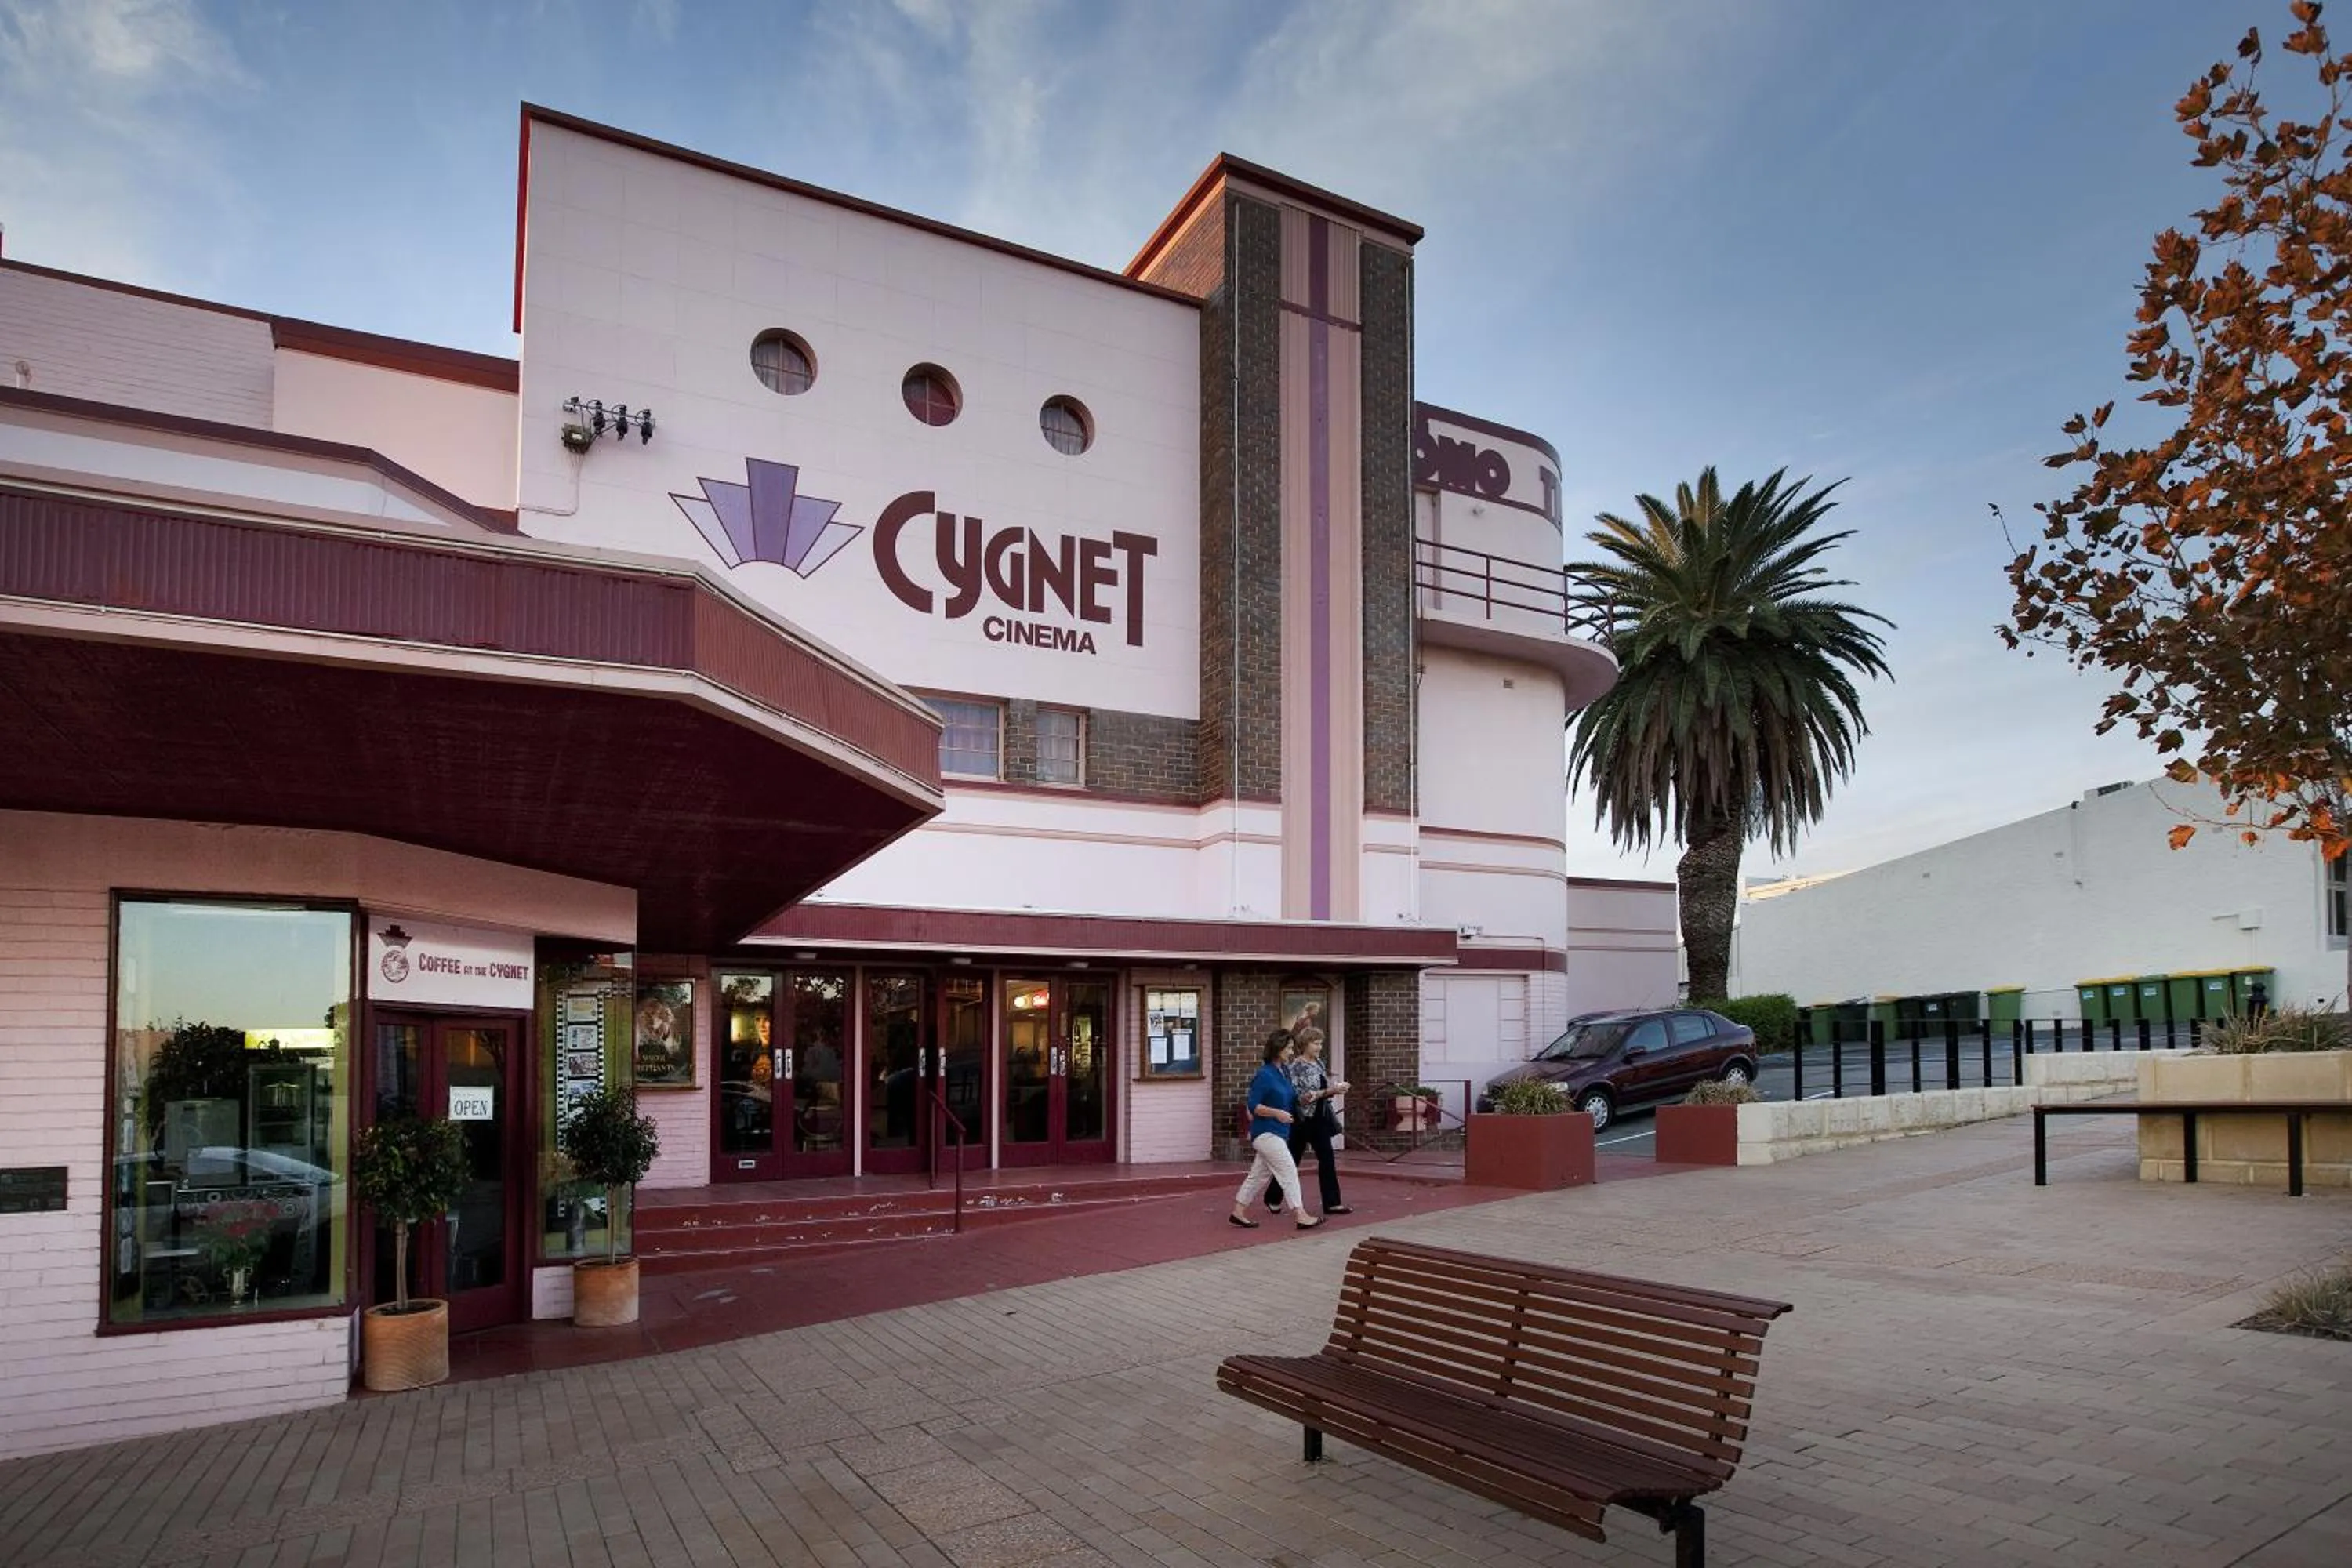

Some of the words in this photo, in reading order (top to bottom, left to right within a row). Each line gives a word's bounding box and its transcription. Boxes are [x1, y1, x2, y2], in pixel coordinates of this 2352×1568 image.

[1414, 419, 1510, 499] OMO
[873, 490, 1158, 648] CYGNET
[982, 615, 1096, 655] CINEMA
[419, 953, 461, 975] COFFEE
[463, 965, 473, 975] AT
[489, 962, 529, 981] CYGNET
[454, 1100, 488, 1116] OPEN
